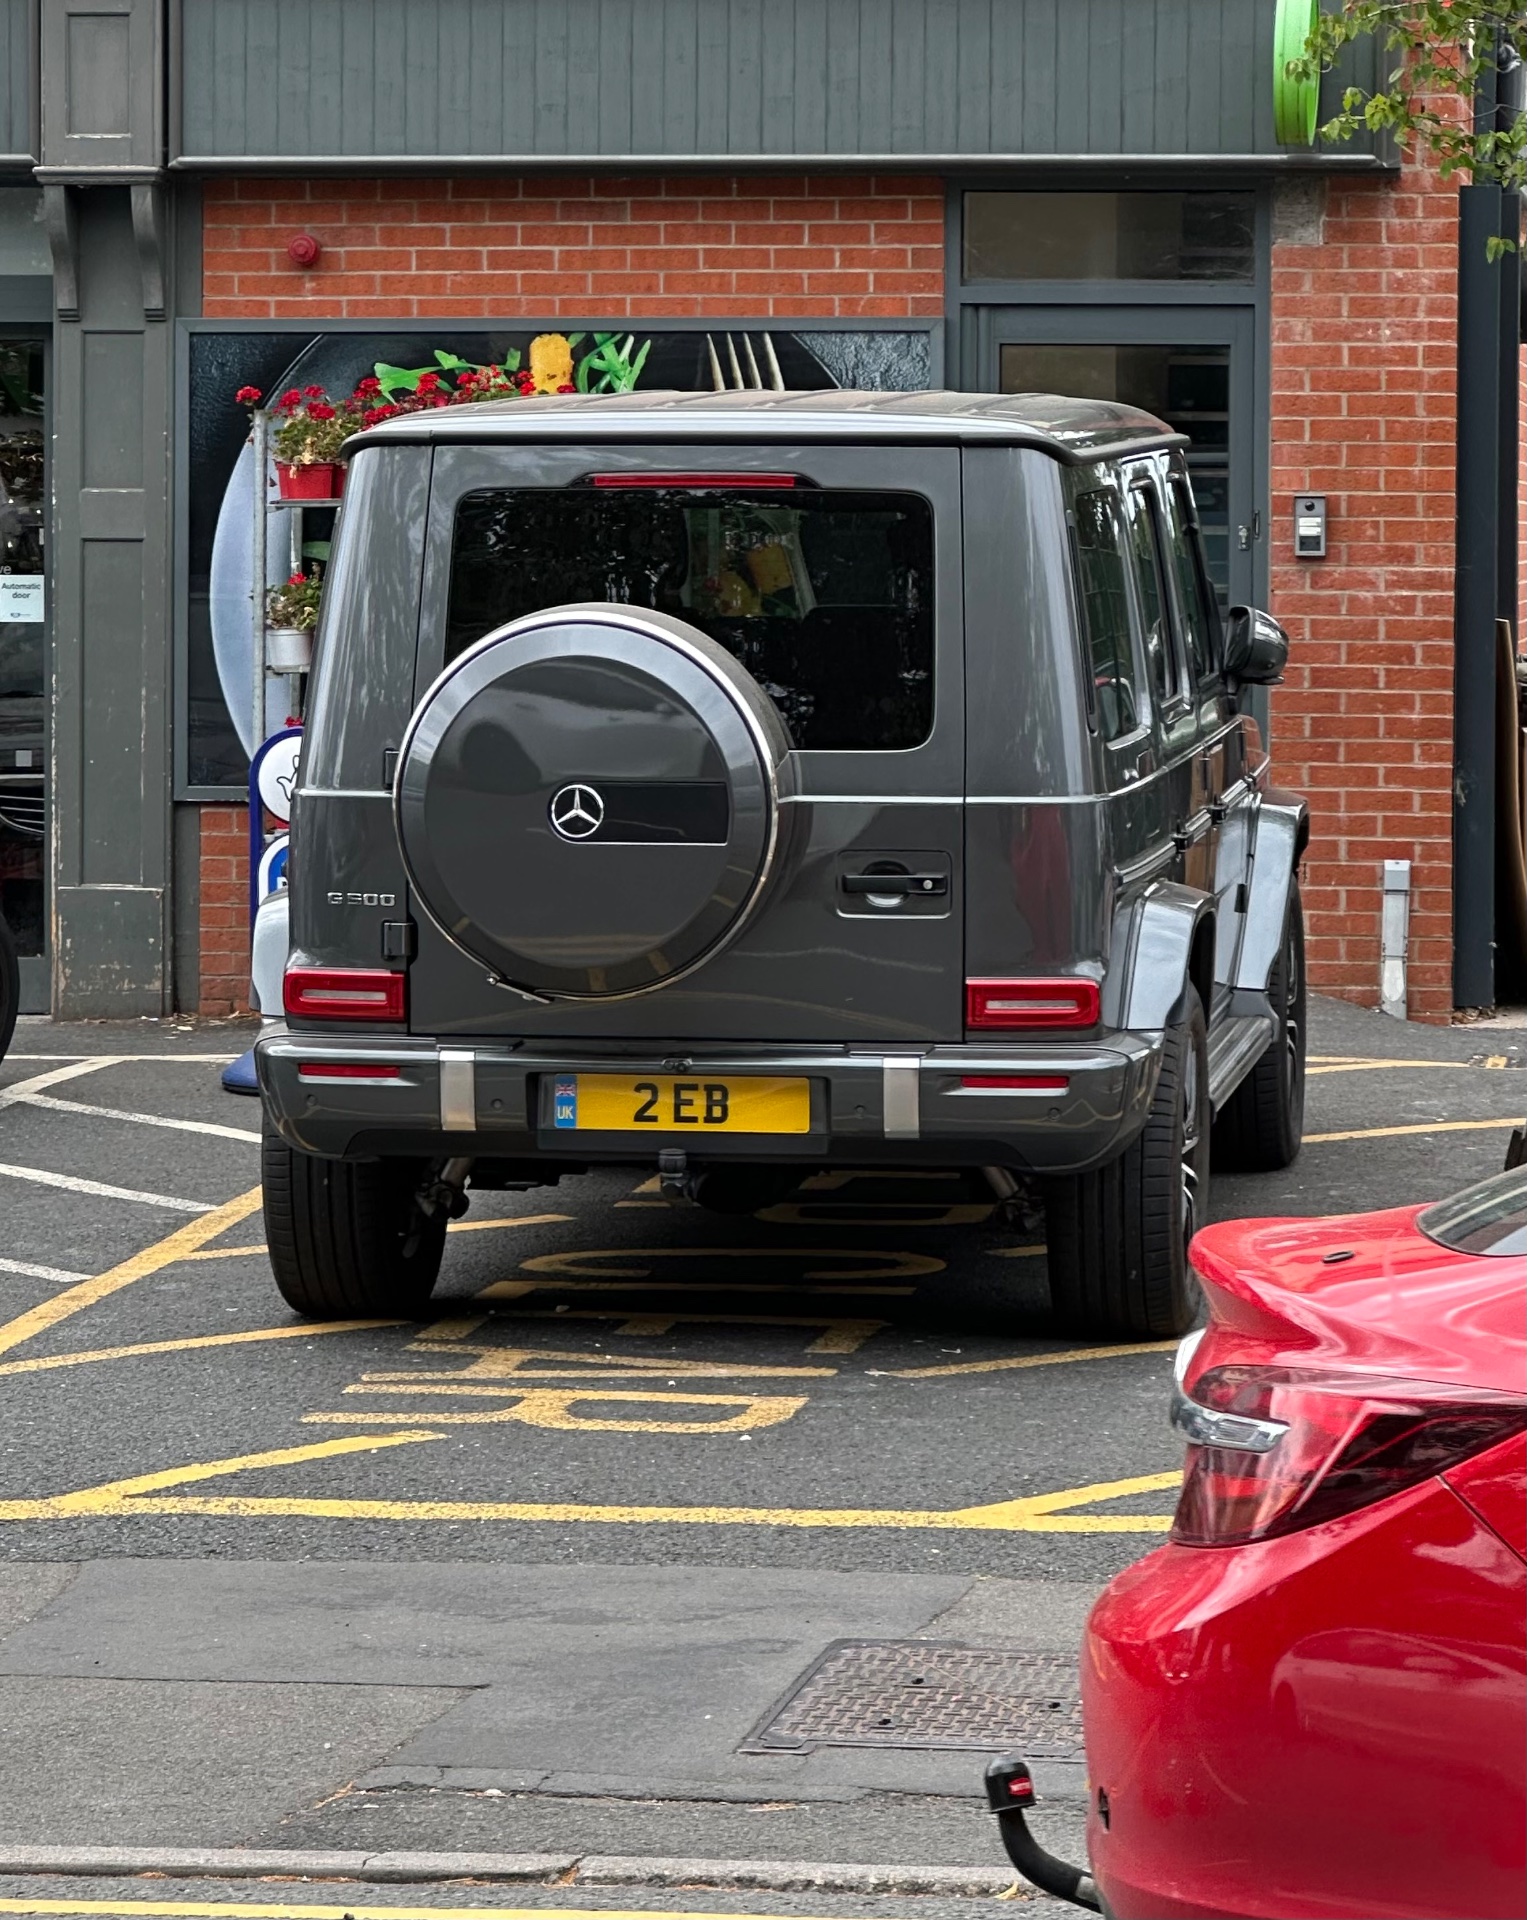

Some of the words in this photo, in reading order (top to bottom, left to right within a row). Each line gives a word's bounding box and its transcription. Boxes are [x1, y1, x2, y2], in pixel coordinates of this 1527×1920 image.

[12, 591, 31, 599] door
[327, 892, 343, 905] G
[346, 892, 395, 906] 500
[633, 1082, 659, 1123] 2
[673, 1083, 729, 1124] EB
[557, 1105, 574, 1120] UK
[300, 1248, 948, 1434] CLEAR
